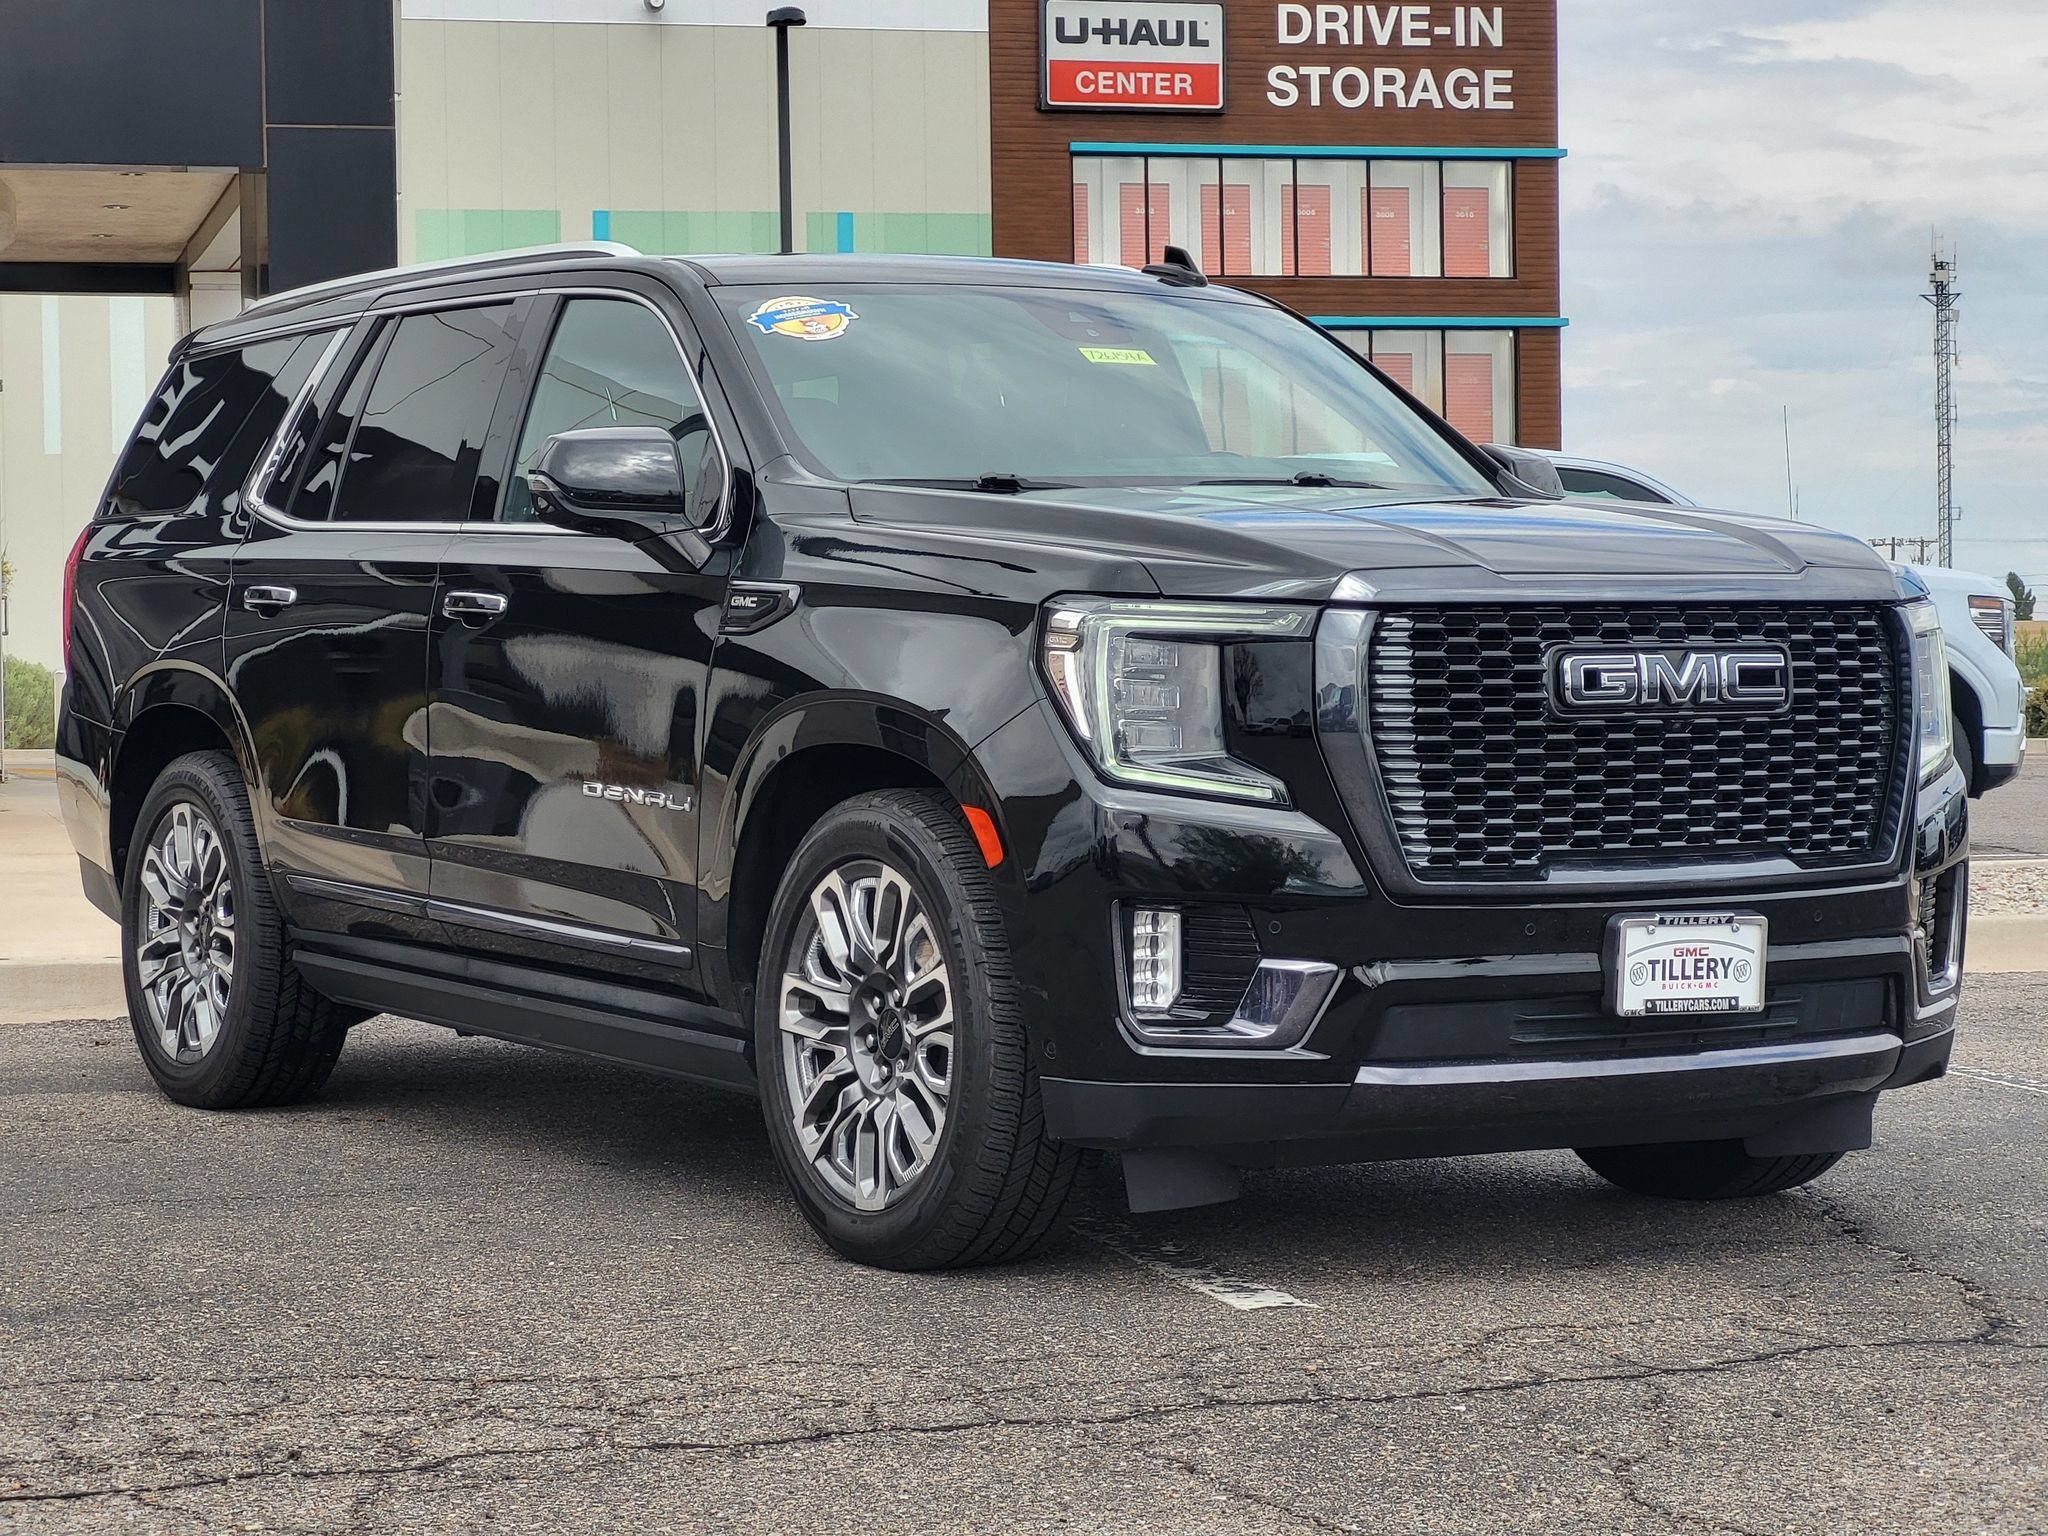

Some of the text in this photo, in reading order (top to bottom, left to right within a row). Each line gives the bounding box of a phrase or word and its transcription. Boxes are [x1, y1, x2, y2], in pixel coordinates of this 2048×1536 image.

[1056, 17, 1209, 47] U-HAUL
[1278, 4, 1503, 47] DRIVE-IN
[1076, 71, 1192, 95] CENTER
[1266, 65, 1514, 110] STORAGE
[731, 596, 757, 607] GMC
[1564, 652, 1786, 704] GMC
[582, 780, 692, 812] DENALI
[1663, 916, 1729, 925] TILLERY
[1673, 947, 1709, 957] GMC
[1648, 957, 1733, 981] TILLERY
[1655, 999, 1729, 1012] TILLERYCARS.COM
